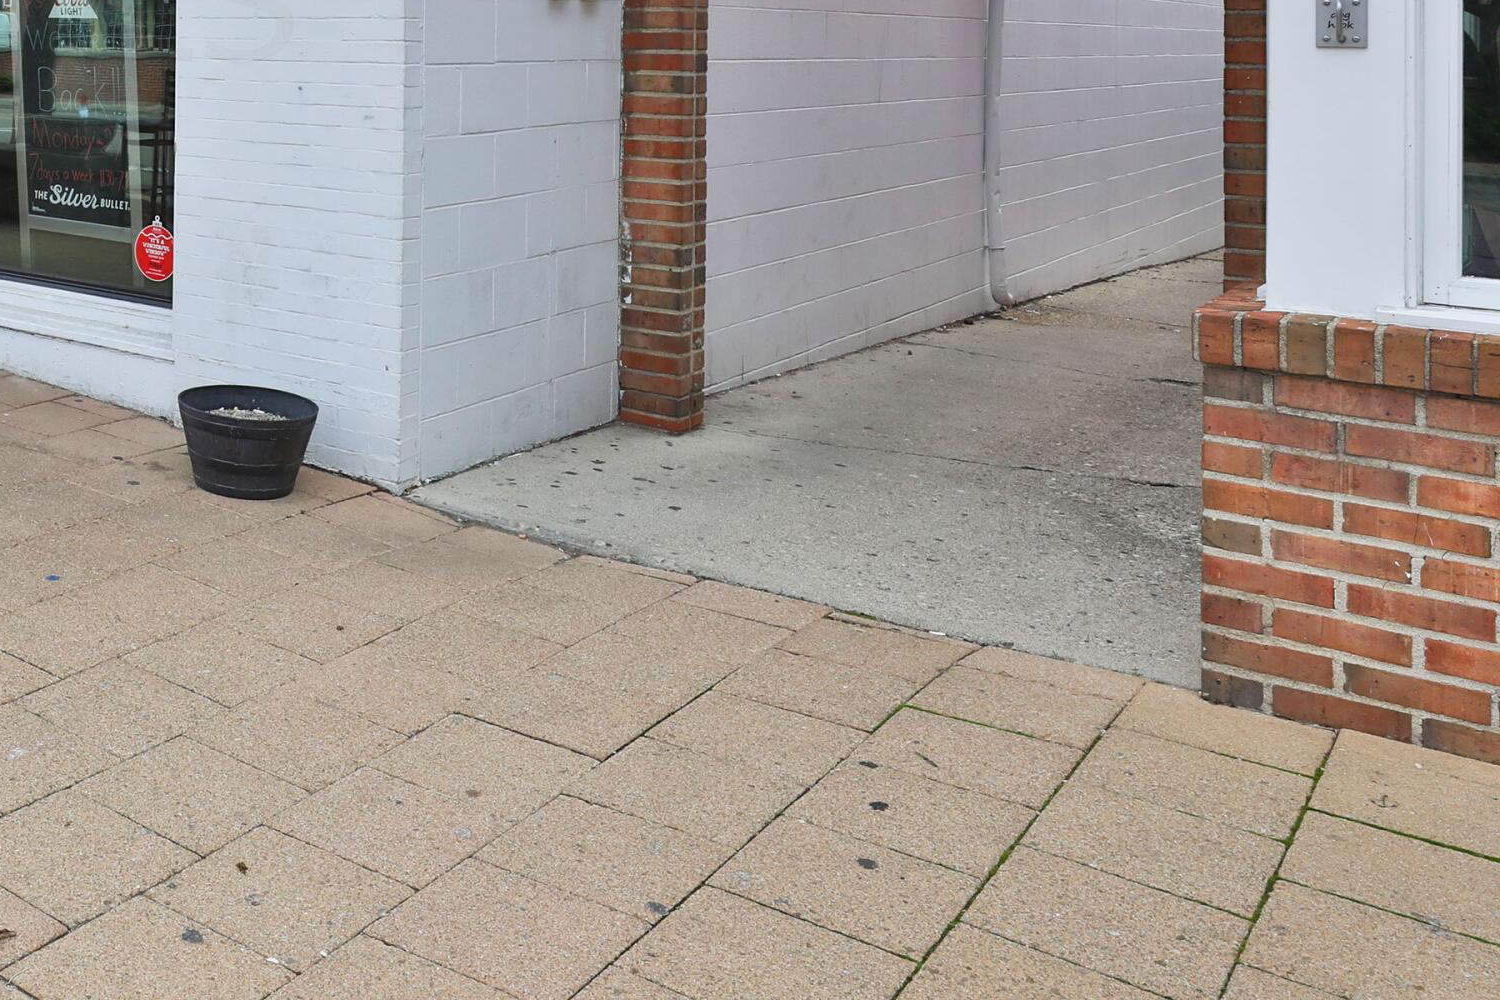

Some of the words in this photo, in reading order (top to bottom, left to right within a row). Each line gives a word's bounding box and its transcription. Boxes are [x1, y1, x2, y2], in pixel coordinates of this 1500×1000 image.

[60, 8, 83, 16] LIGHT
[34, 189, 48, 200] THE
[49, 184, 99, 210] Silver
